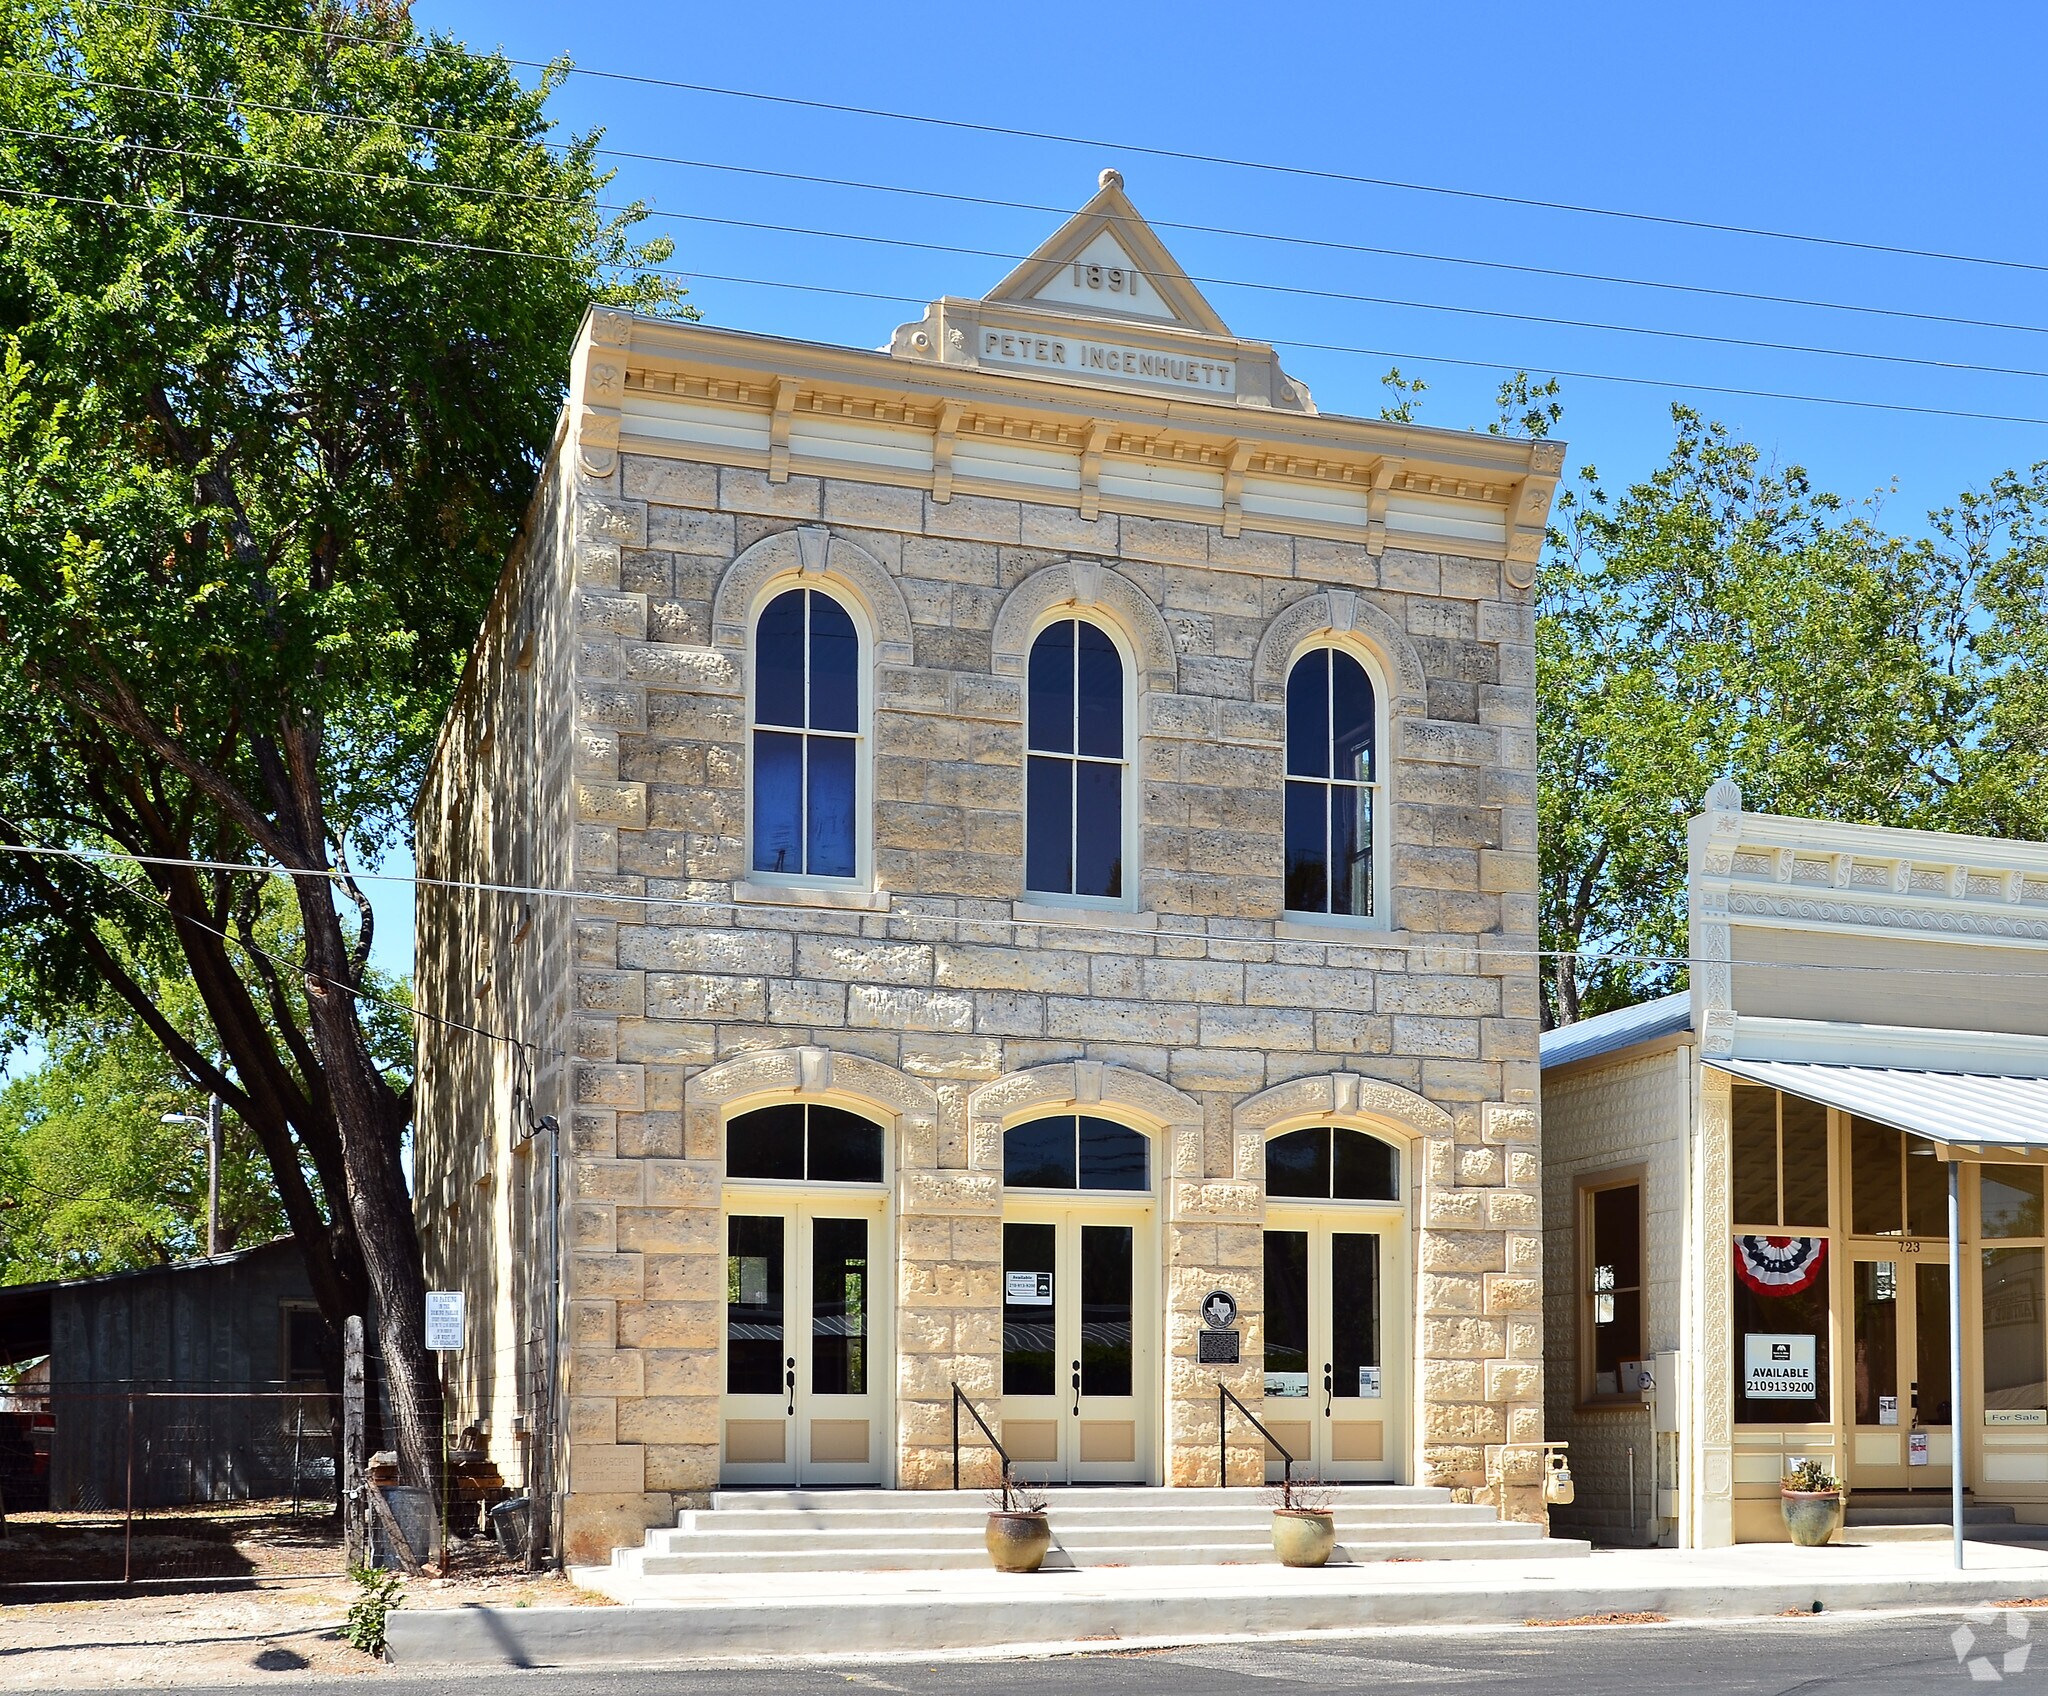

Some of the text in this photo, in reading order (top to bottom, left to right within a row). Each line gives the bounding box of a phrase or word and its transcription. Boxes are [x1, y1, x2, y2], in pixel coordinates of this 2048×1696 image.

[1073, 260, 1137, 296] 1891
[985, 332, 1231, 386] PETER INGENHUETT
[1898, 1241, 1920, 1253] 723
[1753, 1368, 1809, 1378] AVAILABLE
